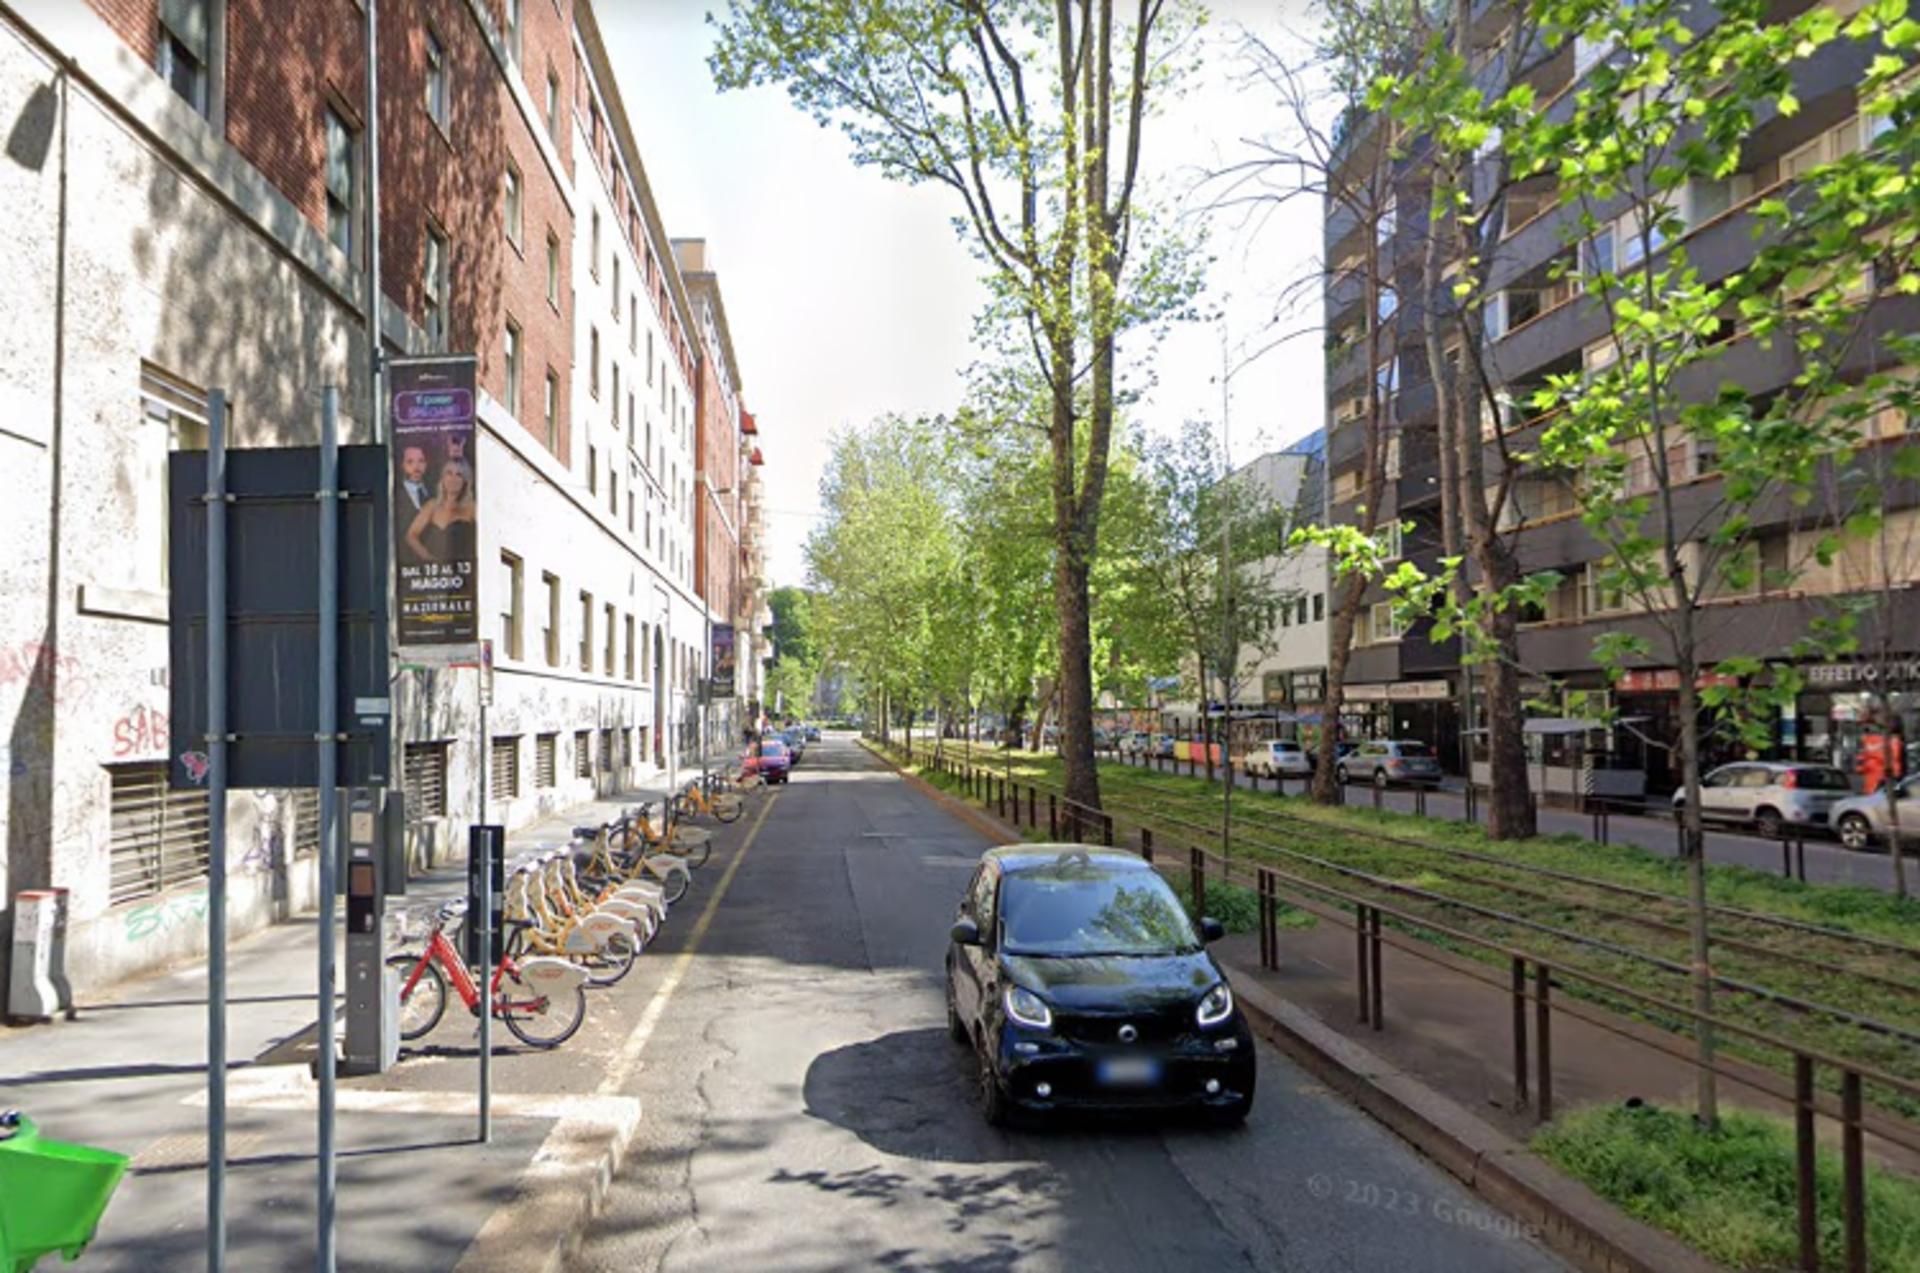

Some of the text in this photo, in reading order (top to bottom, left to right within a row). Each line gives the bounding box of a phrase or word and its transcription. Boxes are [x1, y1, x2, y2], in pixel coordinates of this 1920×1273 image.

[401, 566, 421, 578] DAL
[441, 565, 453, 575] AL
[410, 576, 463, 590] MAGGIO
[403, 601, 471, 613] NAZIONALE
